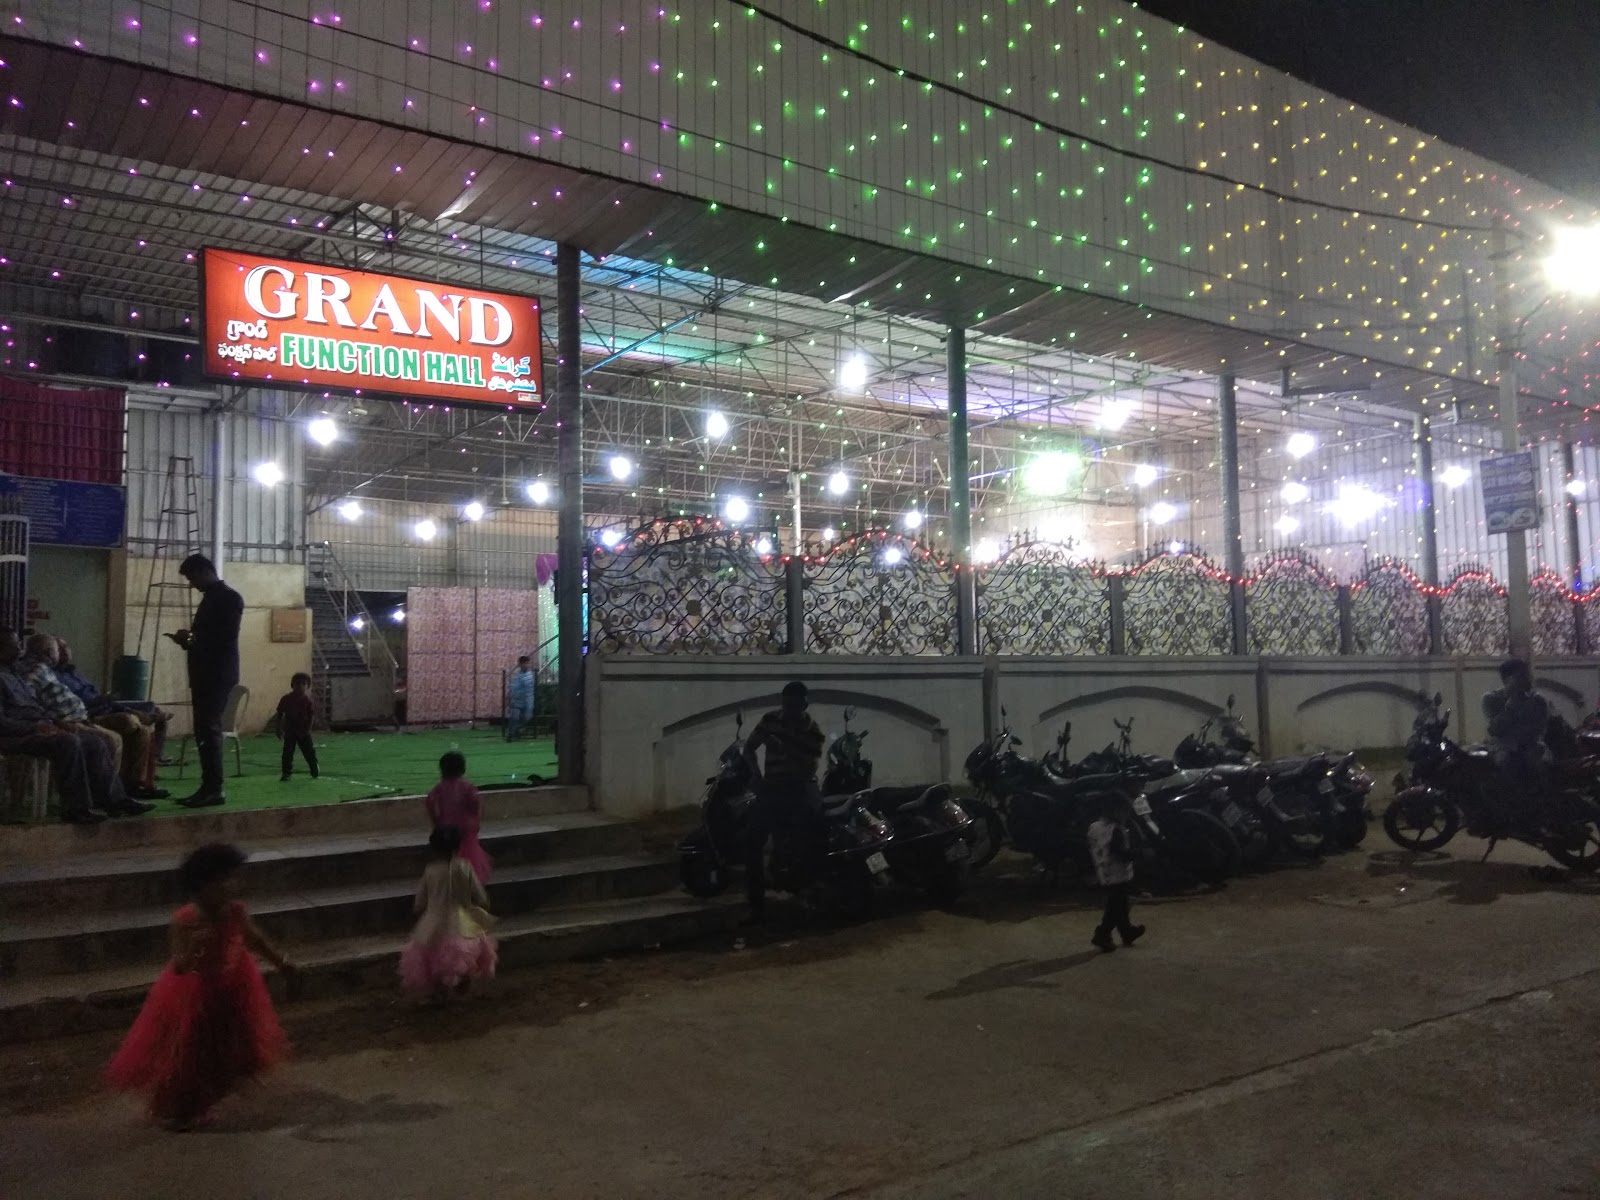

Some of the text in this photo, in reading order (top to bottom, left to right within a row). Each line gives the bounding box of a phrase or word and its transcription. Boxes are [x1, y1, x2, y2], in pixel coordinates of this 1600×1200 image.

[244, 265, 513, 346] GRAND
[280, 333, 486, 388] FUNCTION HALL
